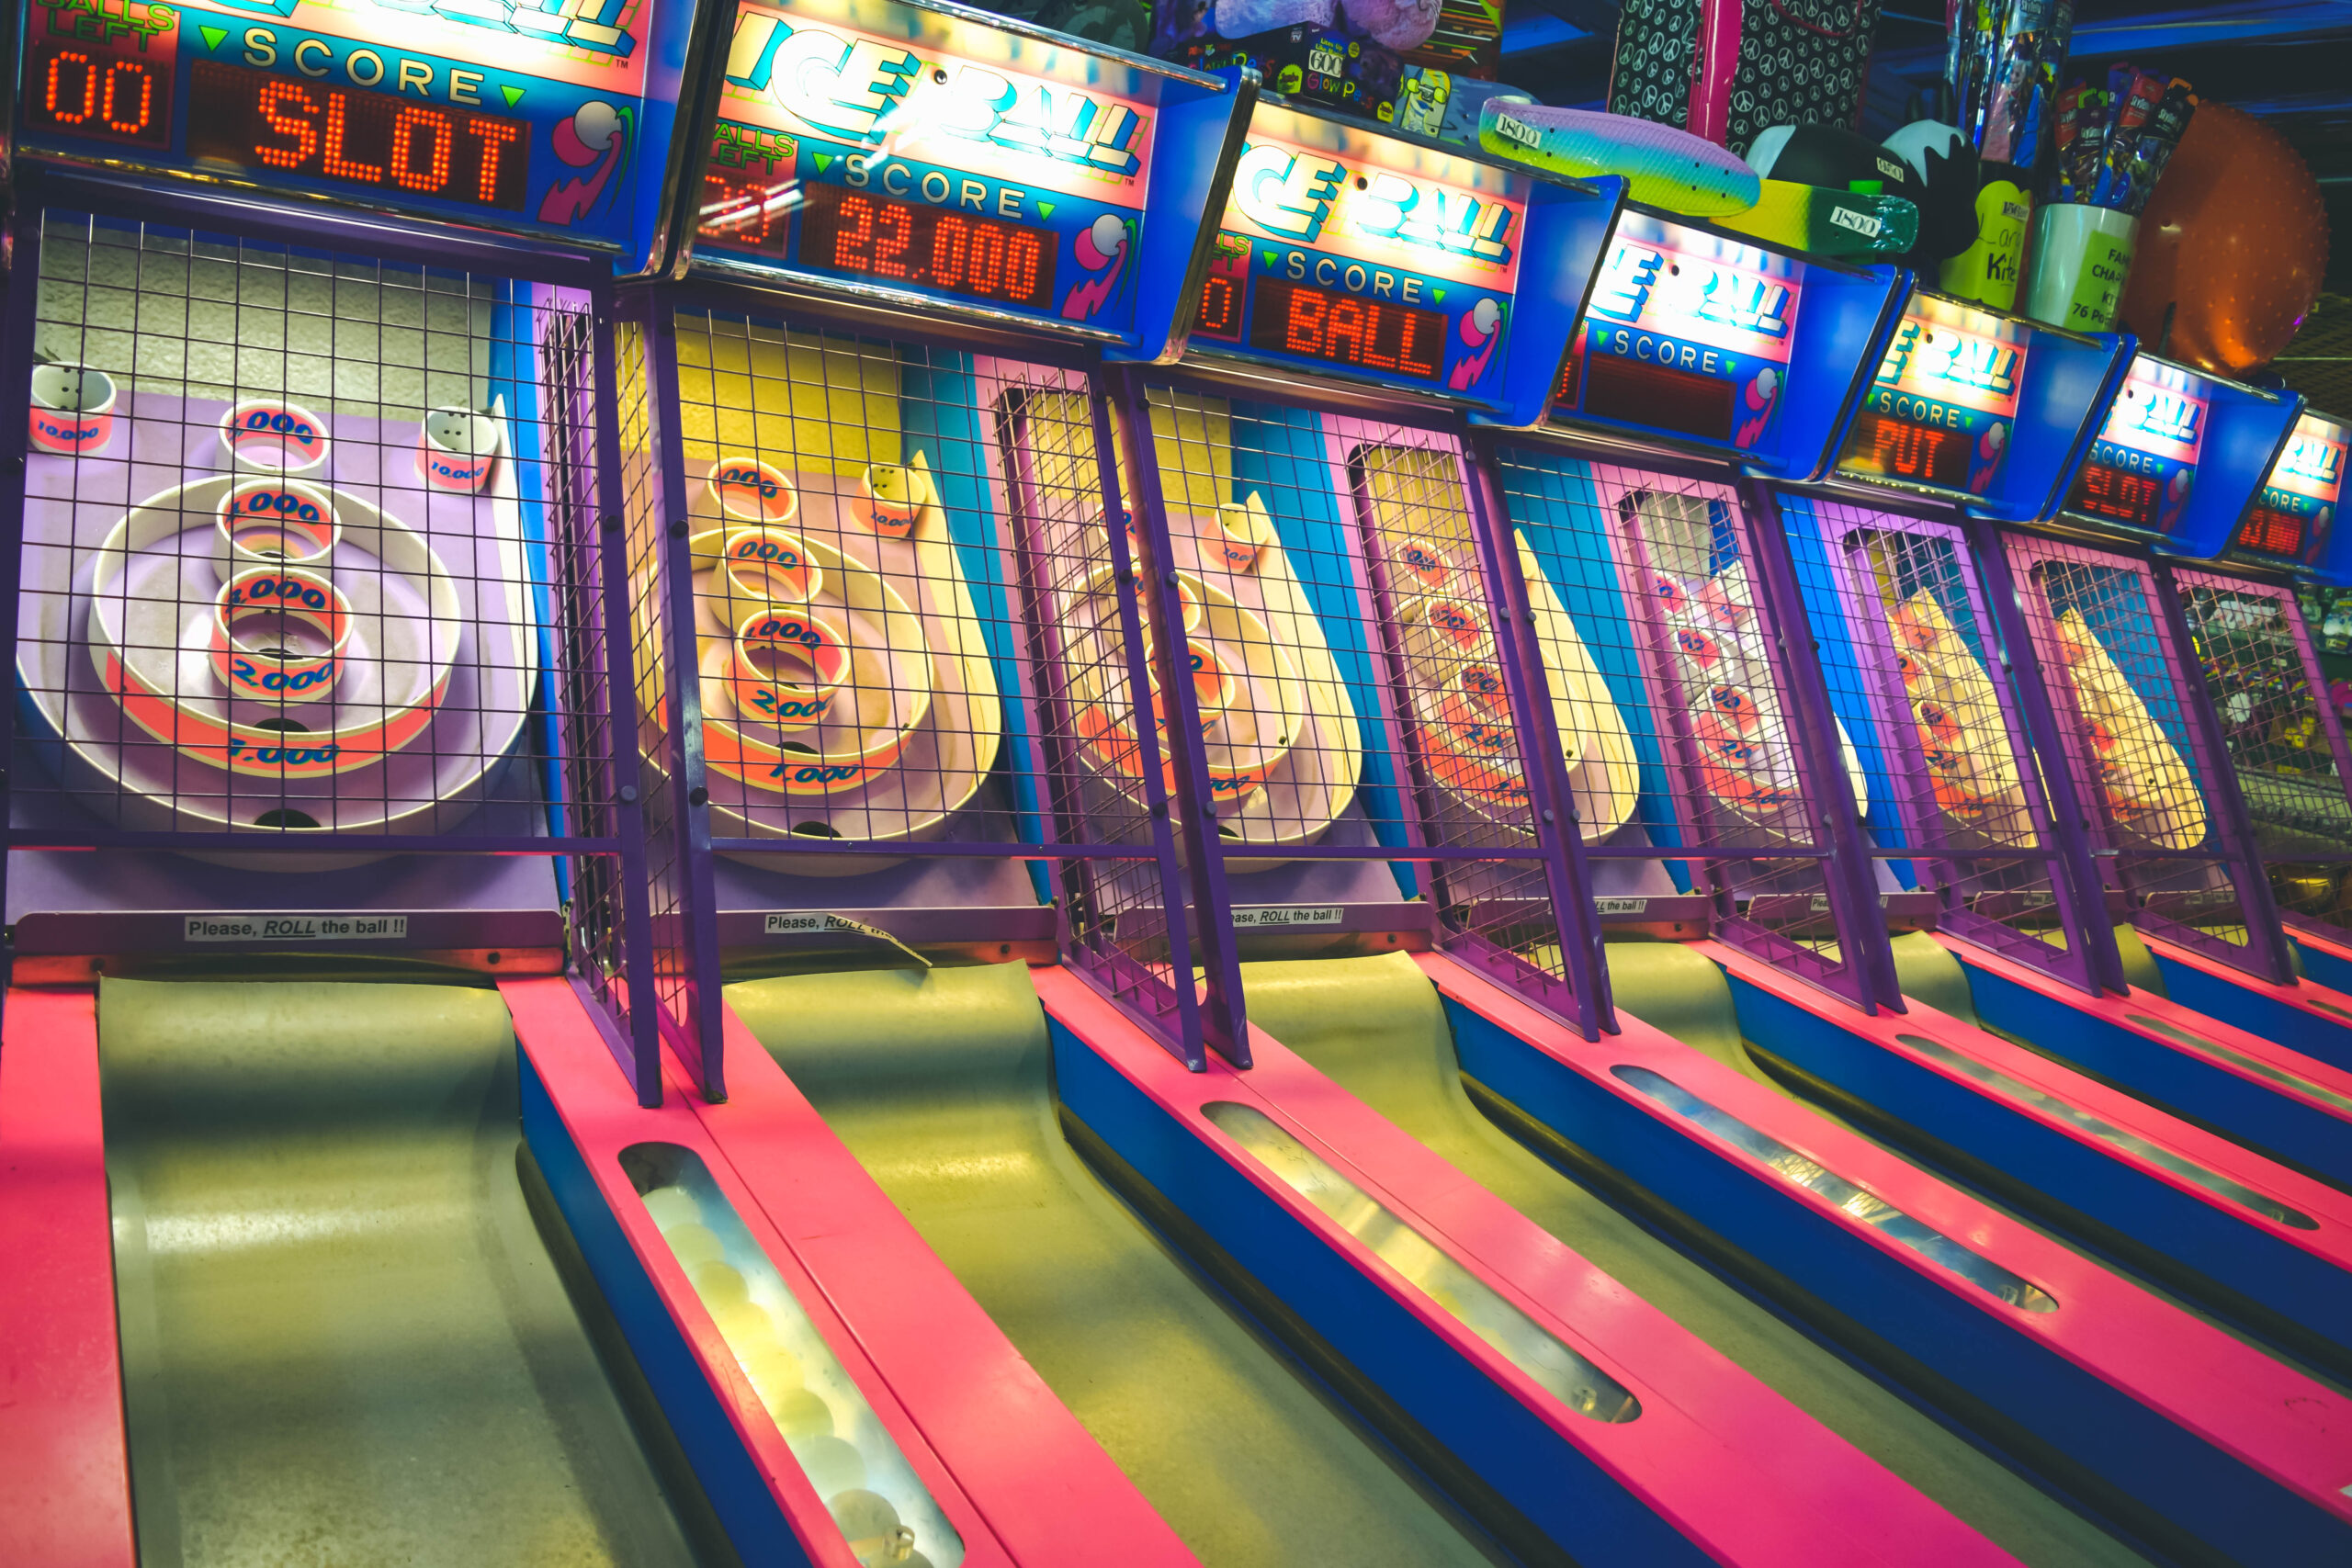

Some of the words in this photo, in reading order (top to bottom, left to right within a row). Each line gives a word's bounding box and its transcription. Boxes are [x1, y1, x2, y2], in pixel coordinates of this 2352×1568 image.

[48, 9, 159, 52] LEFT
[243, 27, 485, 106] SCORE
[727, 10, 922, 145] ICE
[255, 80, 517, 202] SLOT
[713, 123, 795, 158] ALLS
[1499, 116, 1538, 145] 1800
[708, 143, 782, 175] EFT
[845, 152, 1026, 220] SCORE
[1231, 145, 1348, 243] CE
[1836, 209, 1877, 234] 1800
[1286, 251, 1425, 304] SCORE
[2073, 302, 2089, 318] 76
[1286, 288, 1432, 375] BALL
[1614, 330, 1719, 374] SCORE
[1879, 393, 1961, 429] SCORE
[1871, 420, 1945, 478] PUT
[2088, 442, 2154, 474] SCORE
[2258, 489, 2301, 513] CORE
[232, 659, 333, 690] 2,000
[1260, 911, 1290, 924] ROLL
[1294, 910, 1309, 920] the
[1313, 909, 1331, 920] ball
[1607, 901, 1620, 910] the
[1623, 901, 1635, 910] ball
[188, 920, 257, 937] Please,
[262, 920, 316, 938] ROLL
[322, 920, 350, 934] the
[356, 919, 388, 933] ball
[768, 917, 820, 931] Please,
